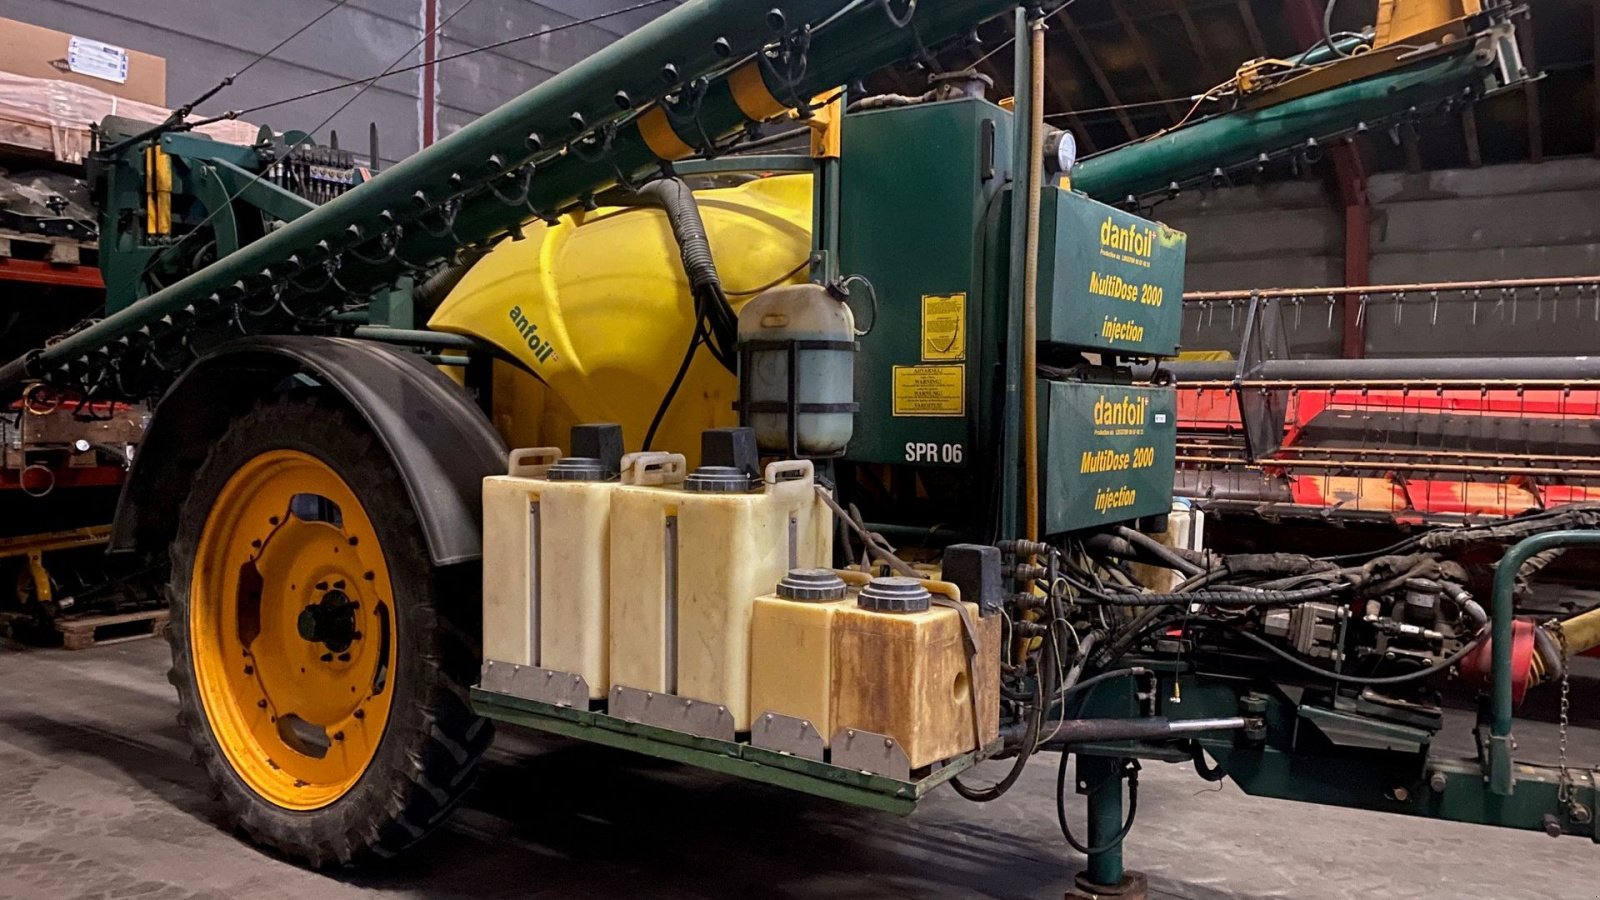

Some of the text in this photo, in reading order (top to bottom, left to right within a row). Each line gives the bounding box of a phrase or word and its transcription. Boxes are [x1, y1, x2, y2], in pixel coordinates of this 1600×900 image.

[1101, 216, 1151, 258] danfoil
[1089, 271, 1163, 307] MultiDose 2000
[1102, 315, 1144, 343] injection
[1094, 395, 1145, 426] danfoil
[905, 442, 963, 463] SPR 06
[1080, 447, 1155, 473] MultiDose 2000
[1094, 485, 1136, 514] injection
